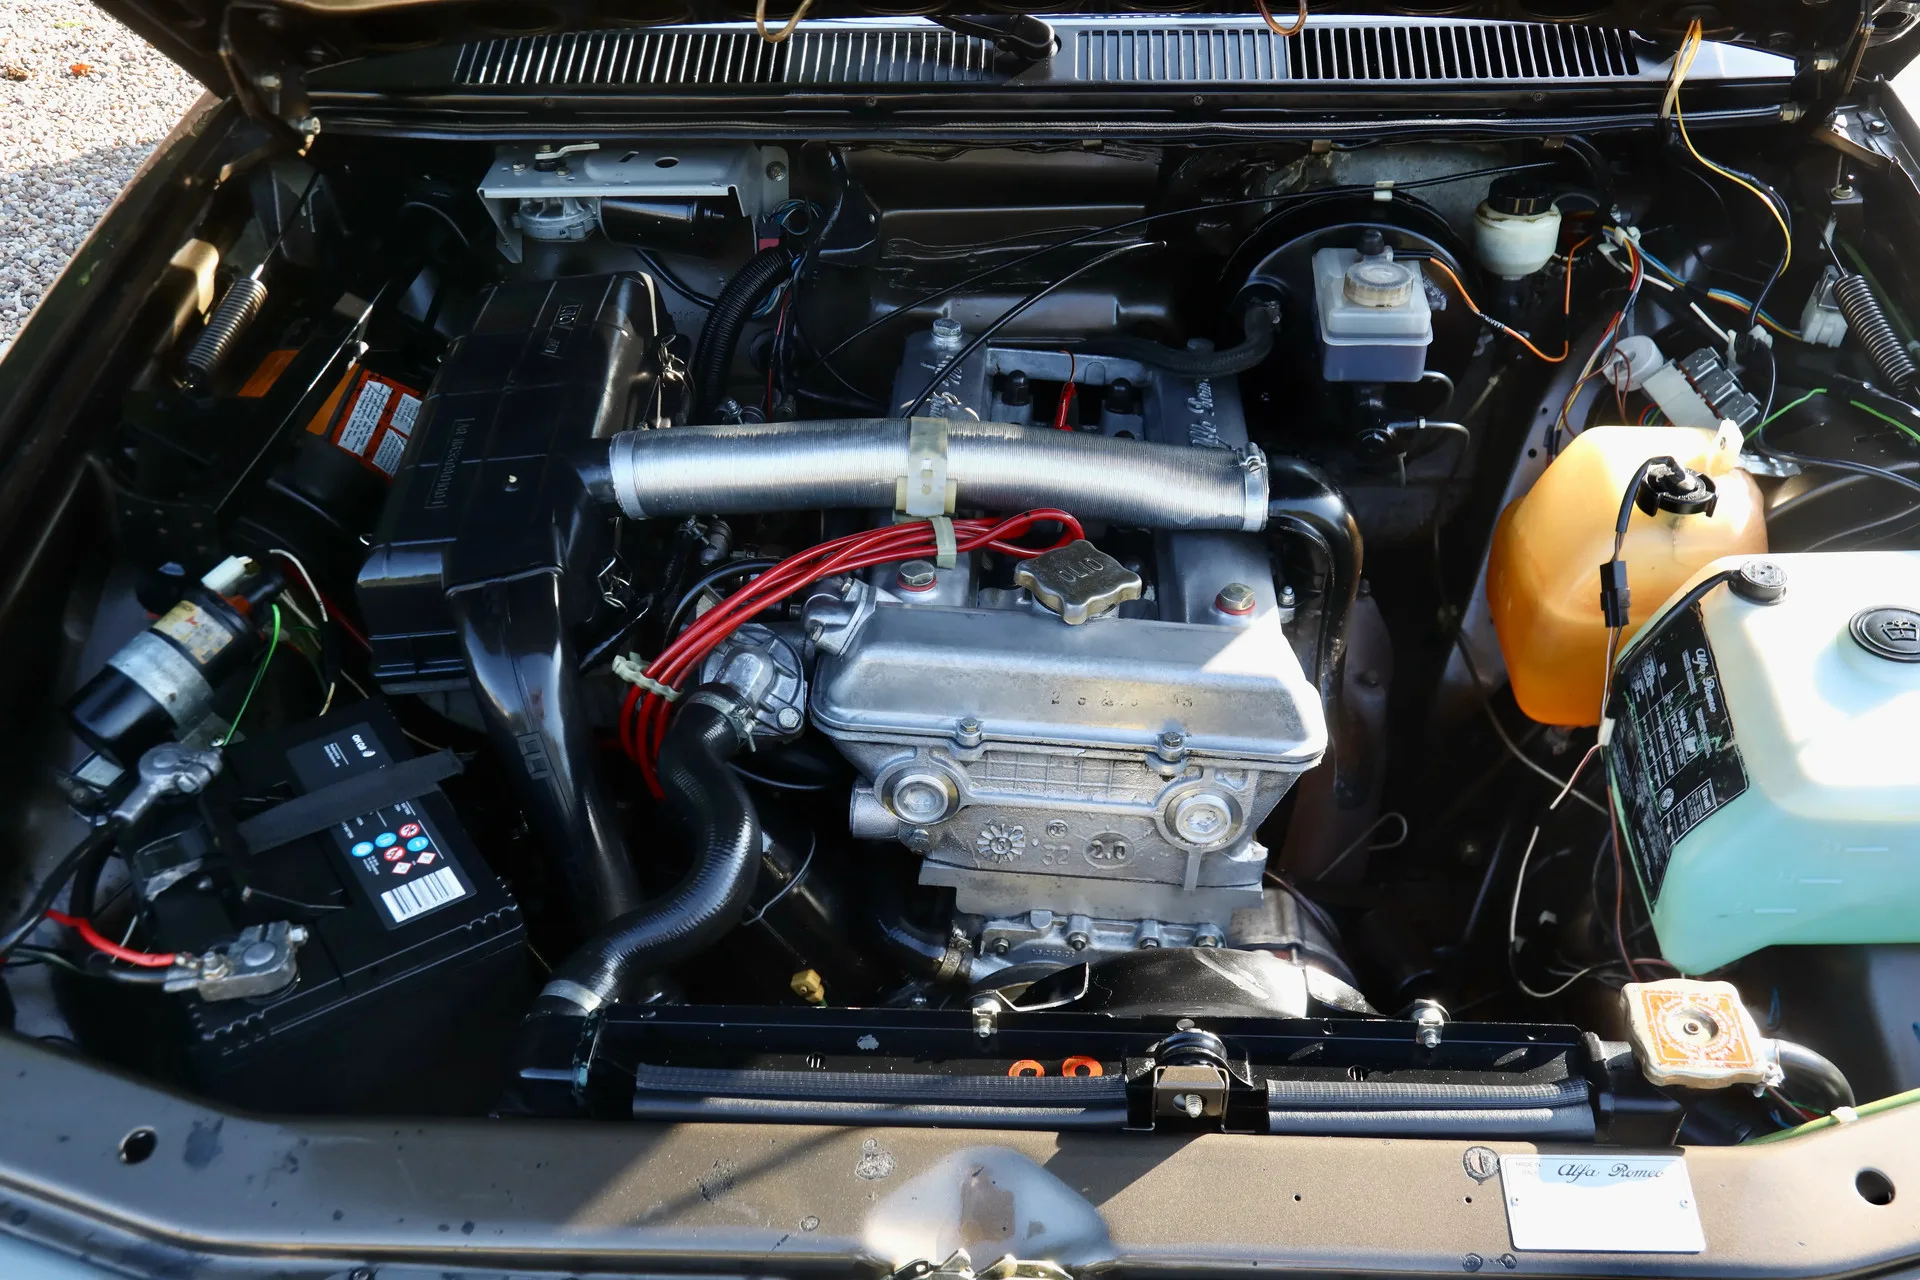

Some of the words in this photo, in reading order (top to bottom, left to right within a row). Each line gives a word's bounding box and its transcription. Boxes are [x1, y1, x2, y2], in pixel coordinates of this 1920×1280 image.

[1058, 557, 1104, 583] OLIO
[1692, 648, 1709, 674] Alfa
[1703, 676, 1717, 713] Romeo
[1042, 844, 1071, 866] 32
[1087, 839, 1127, 860] 2.0
[1557, 1163, 1600, 1183] Alfa
[1608, 1163, 1665, 1179] Romeo
